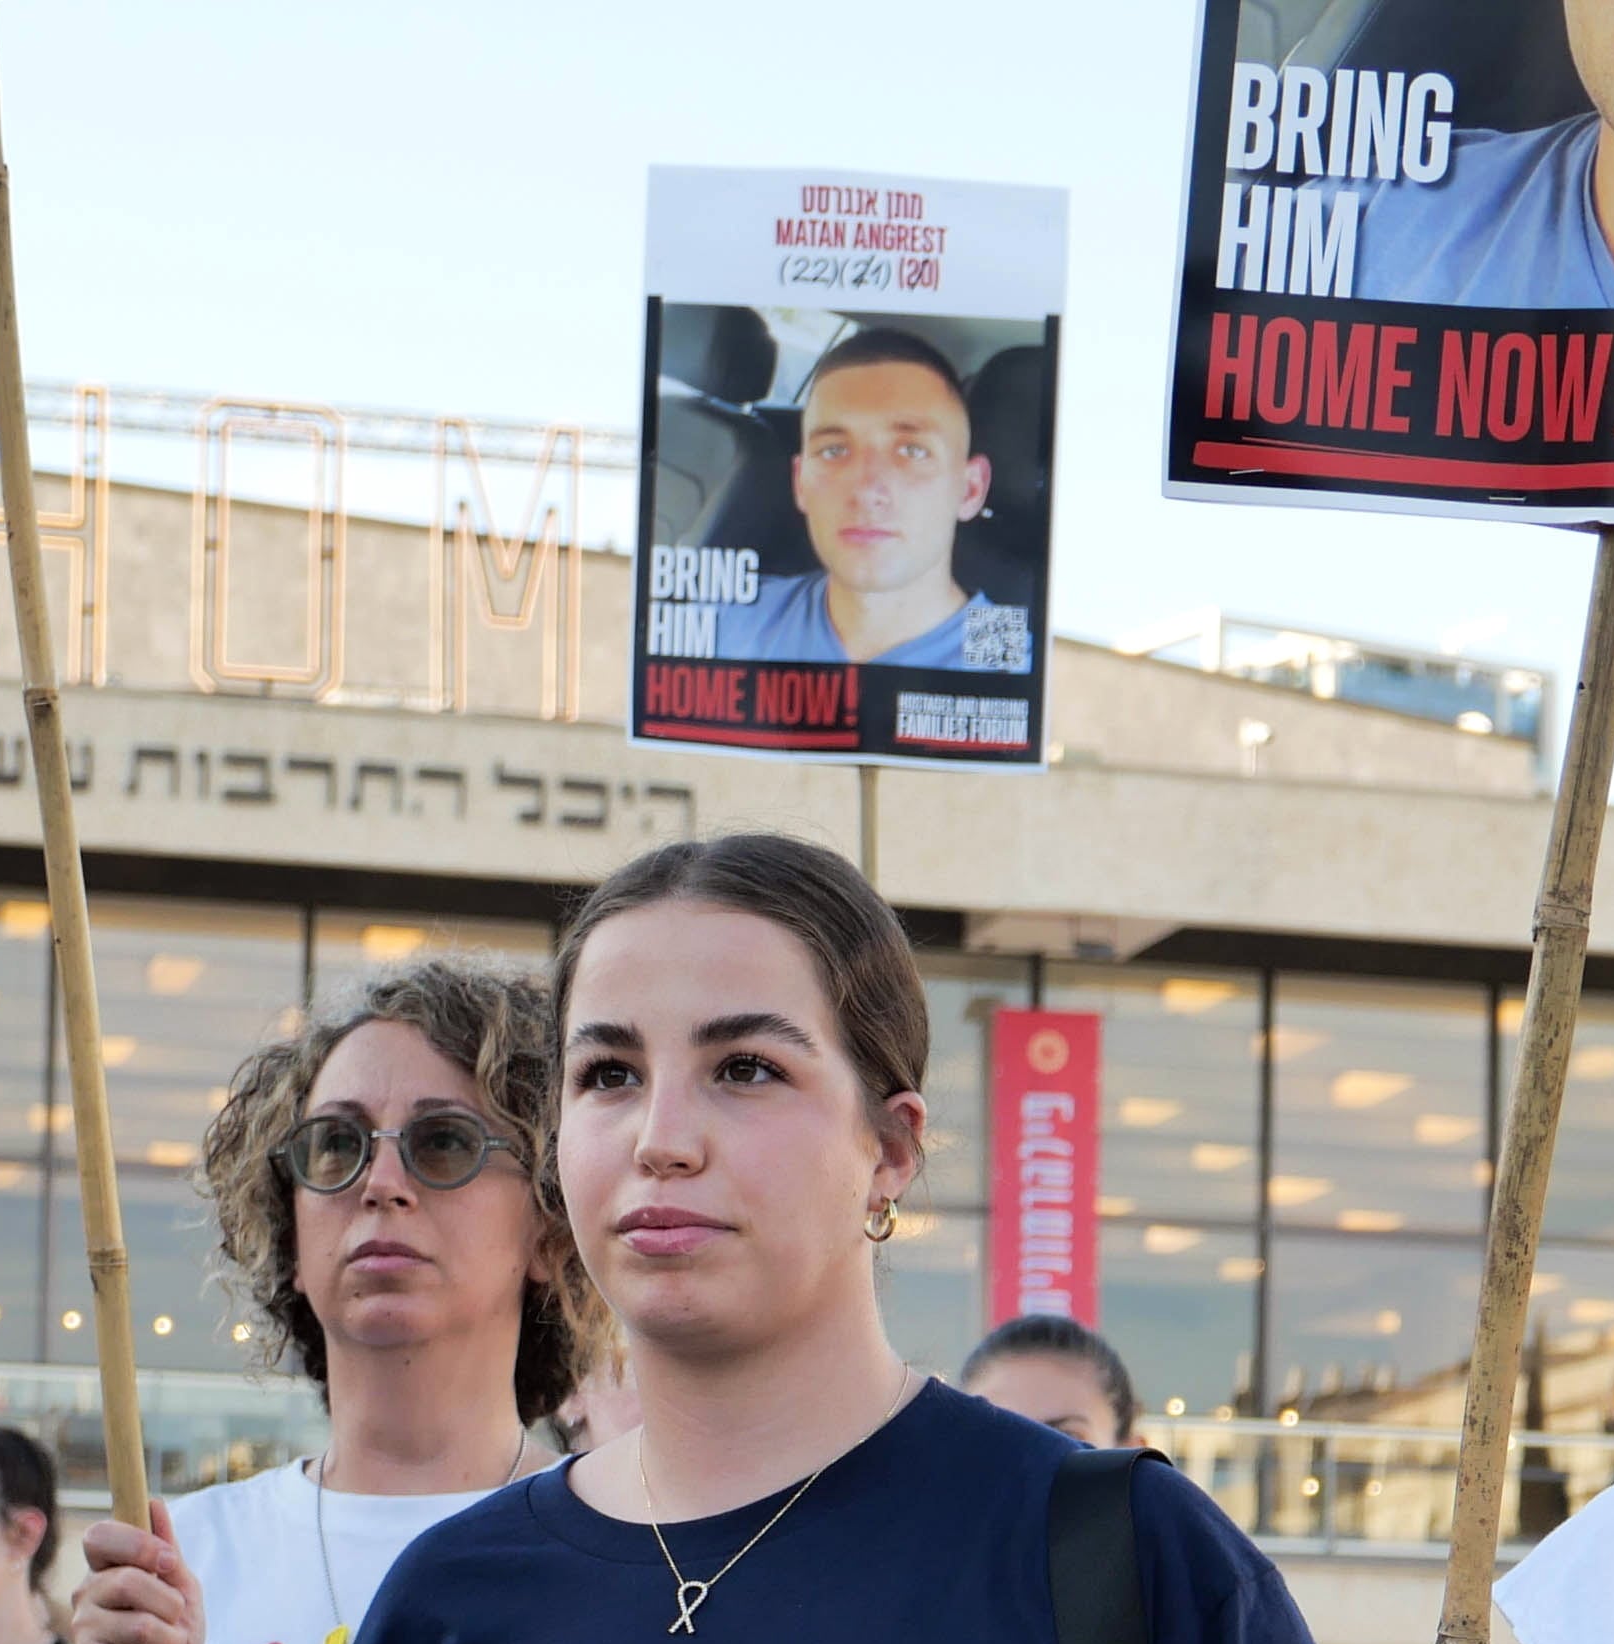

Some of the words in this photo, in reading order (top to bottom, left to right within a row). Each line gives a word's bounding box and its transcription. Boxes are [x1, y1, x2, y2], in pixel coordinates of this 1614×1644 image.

[1226, 63, 1455, 184] BRING
[801, 185, 878, 216] אנגרסט
[886, 192, 923, 220] מתן
[775, 219, 846, 248] MATAN
[853, 223, 946, 253] ANGREST
[1215, 185, 1360, 298] HIM
[1205, 313, 1417, 434] HOME
[651, 545, 759, 604] BRING
[647, 602, 716, 659] HIM
[646, 663, 746, 722] HOME
[756, 665, 858, 726] NOW!
[126, 745, 465, 819] התרבות
[495, 760, 695, 835] היכל
